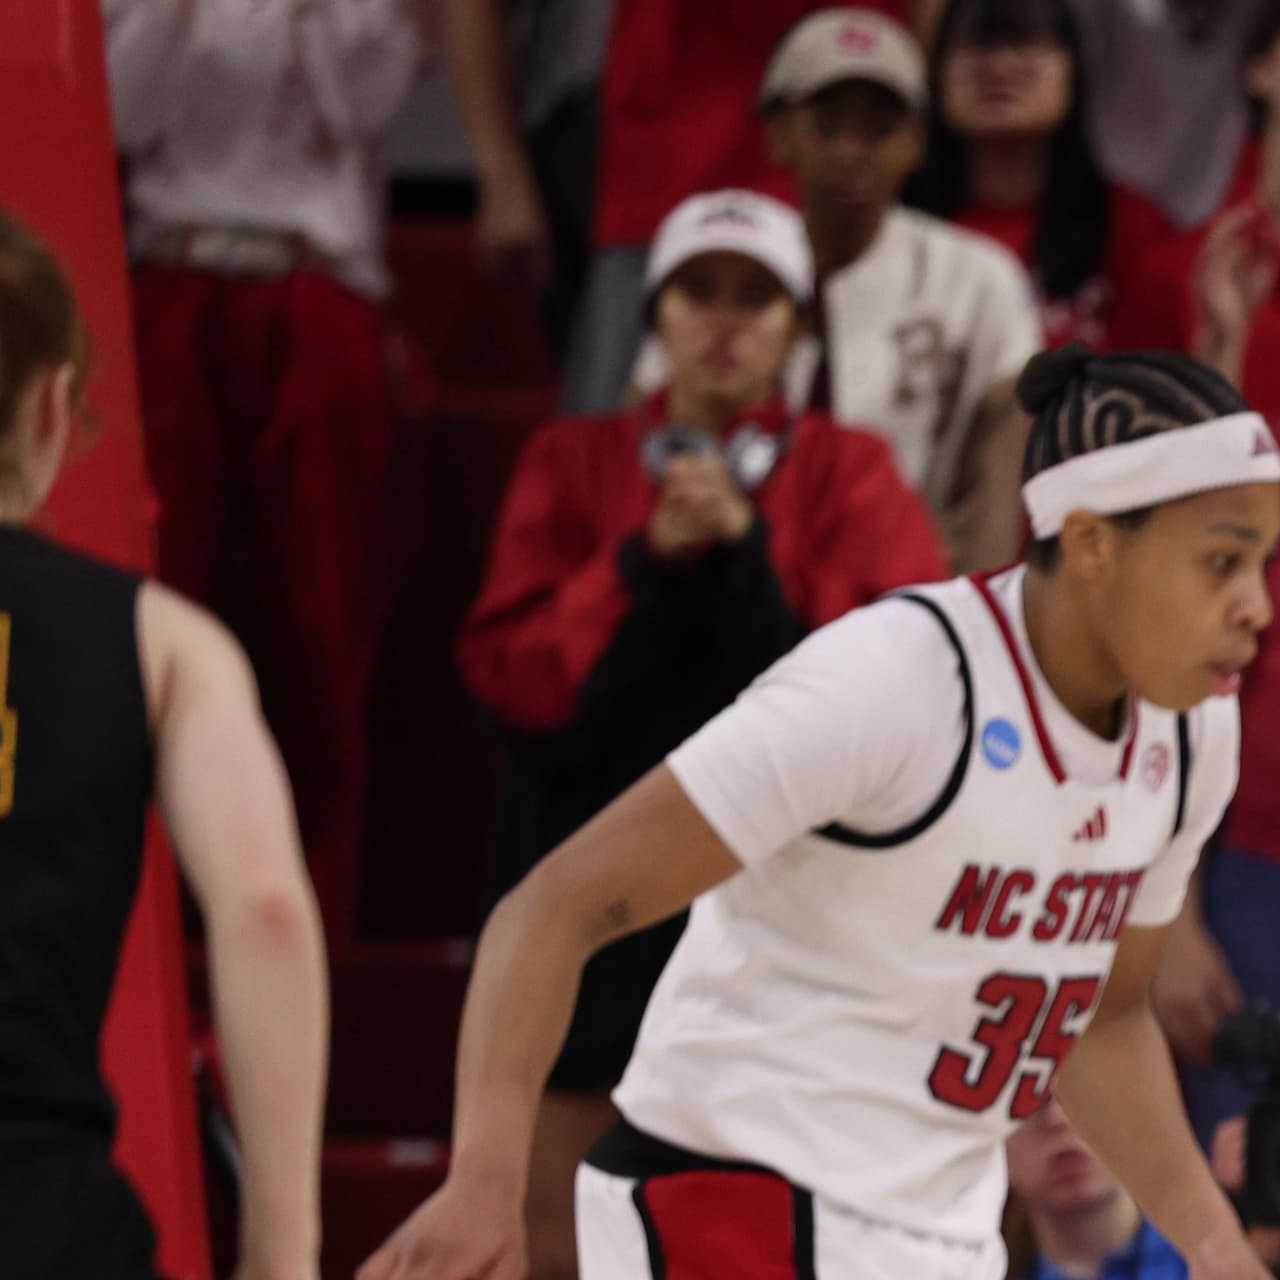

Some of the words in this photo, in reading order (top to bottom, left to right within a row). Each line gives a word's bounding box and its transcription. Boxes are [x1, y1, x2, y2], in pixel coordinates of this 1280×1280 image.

[933, 864, 1036, 940] NC
[1031, 869, 1148, 945] STAT
[927, 968, 1101, 1121] 35
